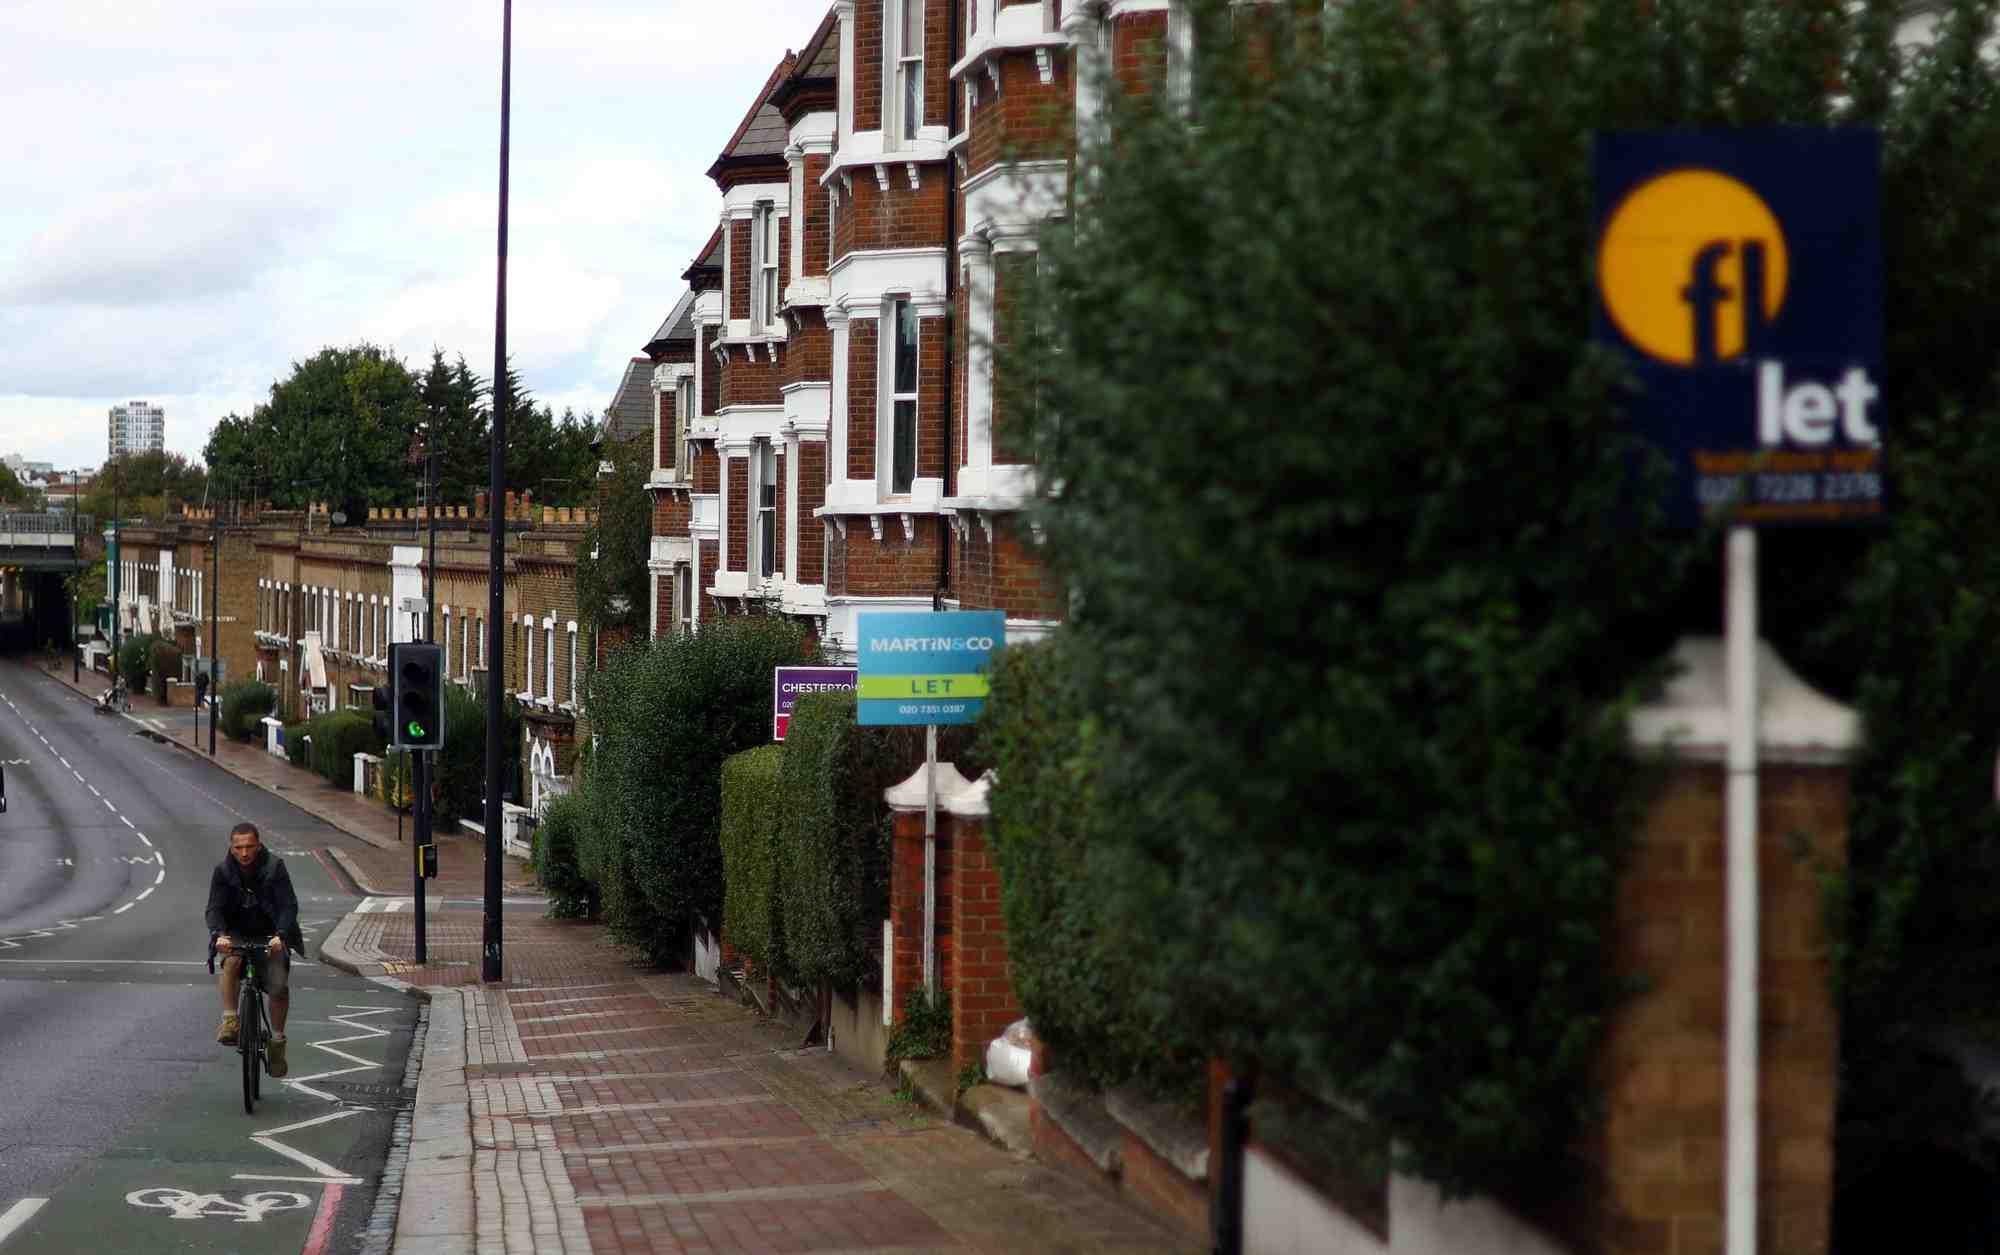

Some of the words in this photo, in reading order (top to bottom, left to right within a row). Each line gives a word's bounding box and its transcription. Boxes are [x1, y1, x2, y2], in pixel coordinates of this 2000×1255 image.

[1758, 360, 1880, 446] let
[870, 636, 993, 652] MARTIN&CO
[911, 680, 954, 693] LET
[899, 704, 919, 714] 020
